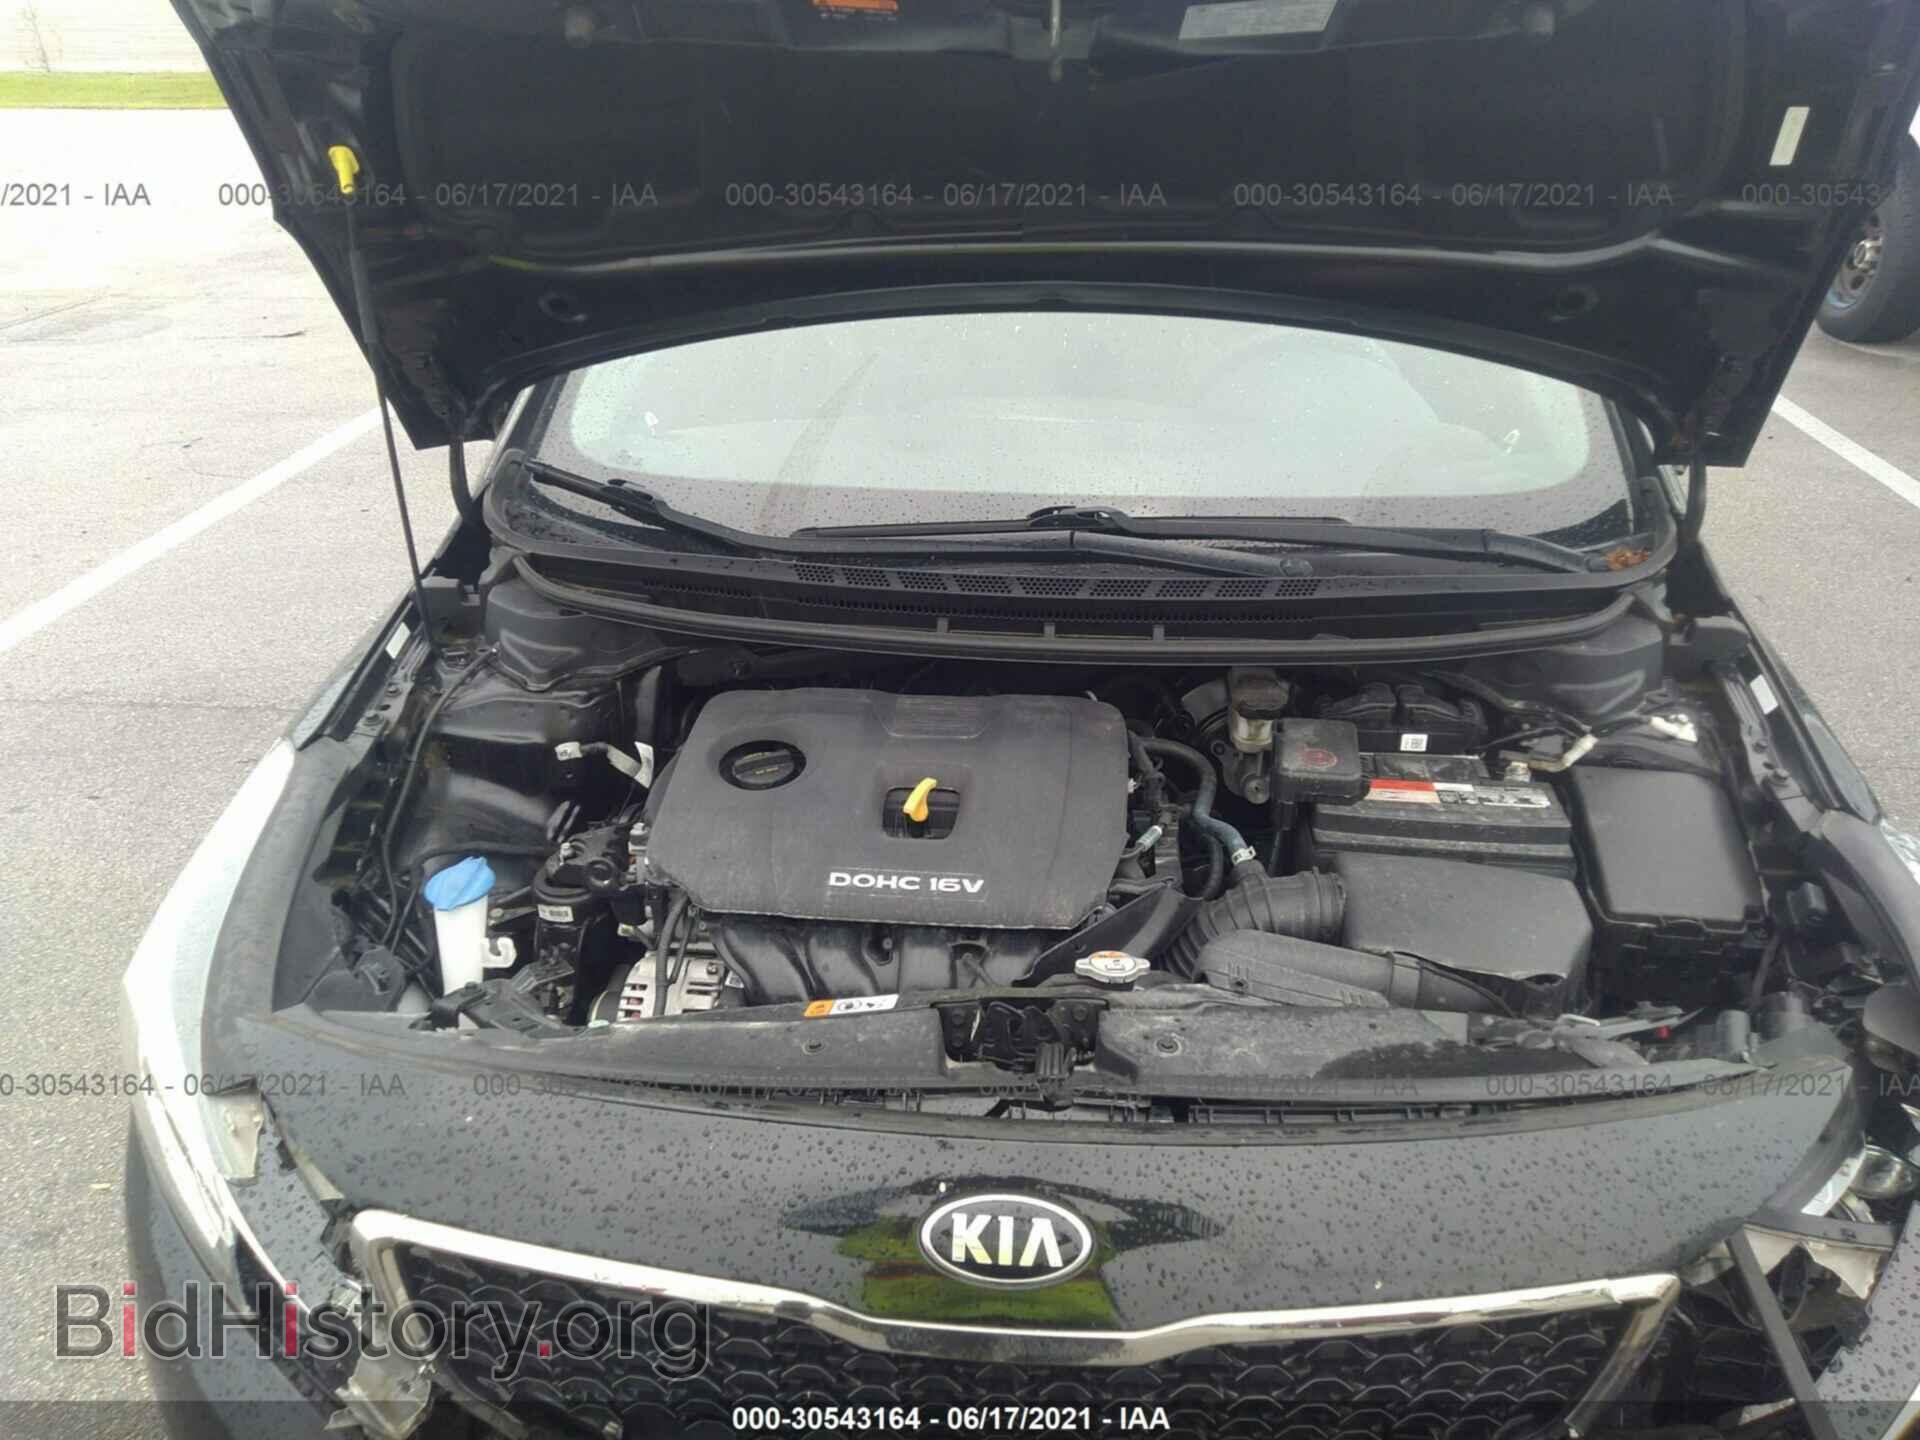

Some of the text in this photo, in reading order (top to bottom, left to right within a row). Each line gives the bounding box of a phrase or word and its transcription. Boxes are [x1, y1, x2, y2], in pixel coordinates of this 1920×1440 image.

[828, 872, 985, 893] DOHC 16V
[951, 1212, 1063, 1267] KIA
